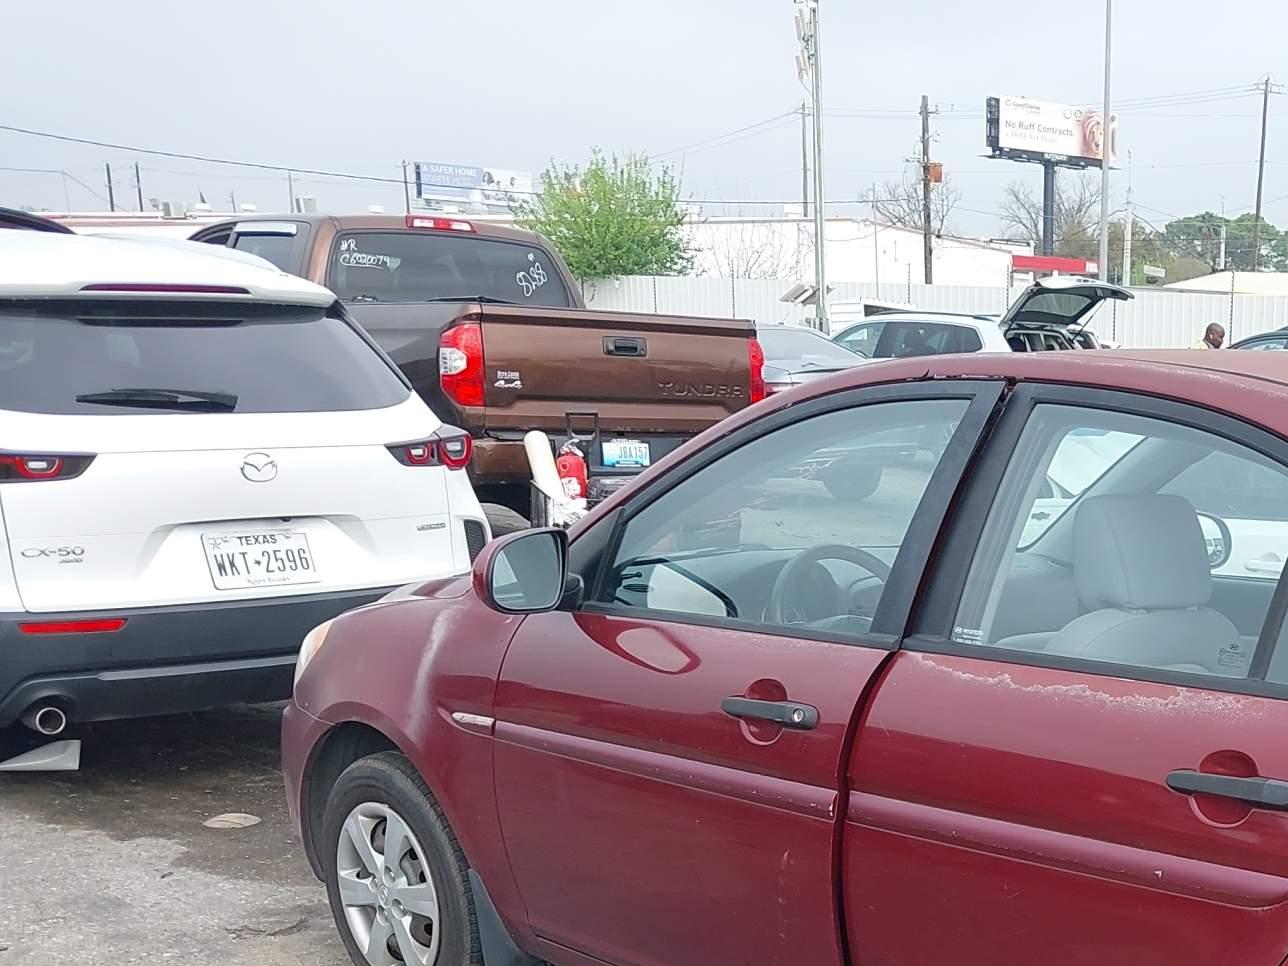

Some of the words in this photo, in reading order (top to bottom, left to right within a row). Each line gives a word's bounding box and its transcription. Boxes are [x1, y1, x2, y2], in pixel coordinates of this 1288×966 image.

[1005, 119, 1016, 129] No
[1018, 121, 1035, 131] Ruff
[455, 167, 478, 177] HOME
[656, 382, 745, 398] TUNDRA
[236, 534, 278, 547] TEXAS
[20, 546, 85, 558] CX-50
